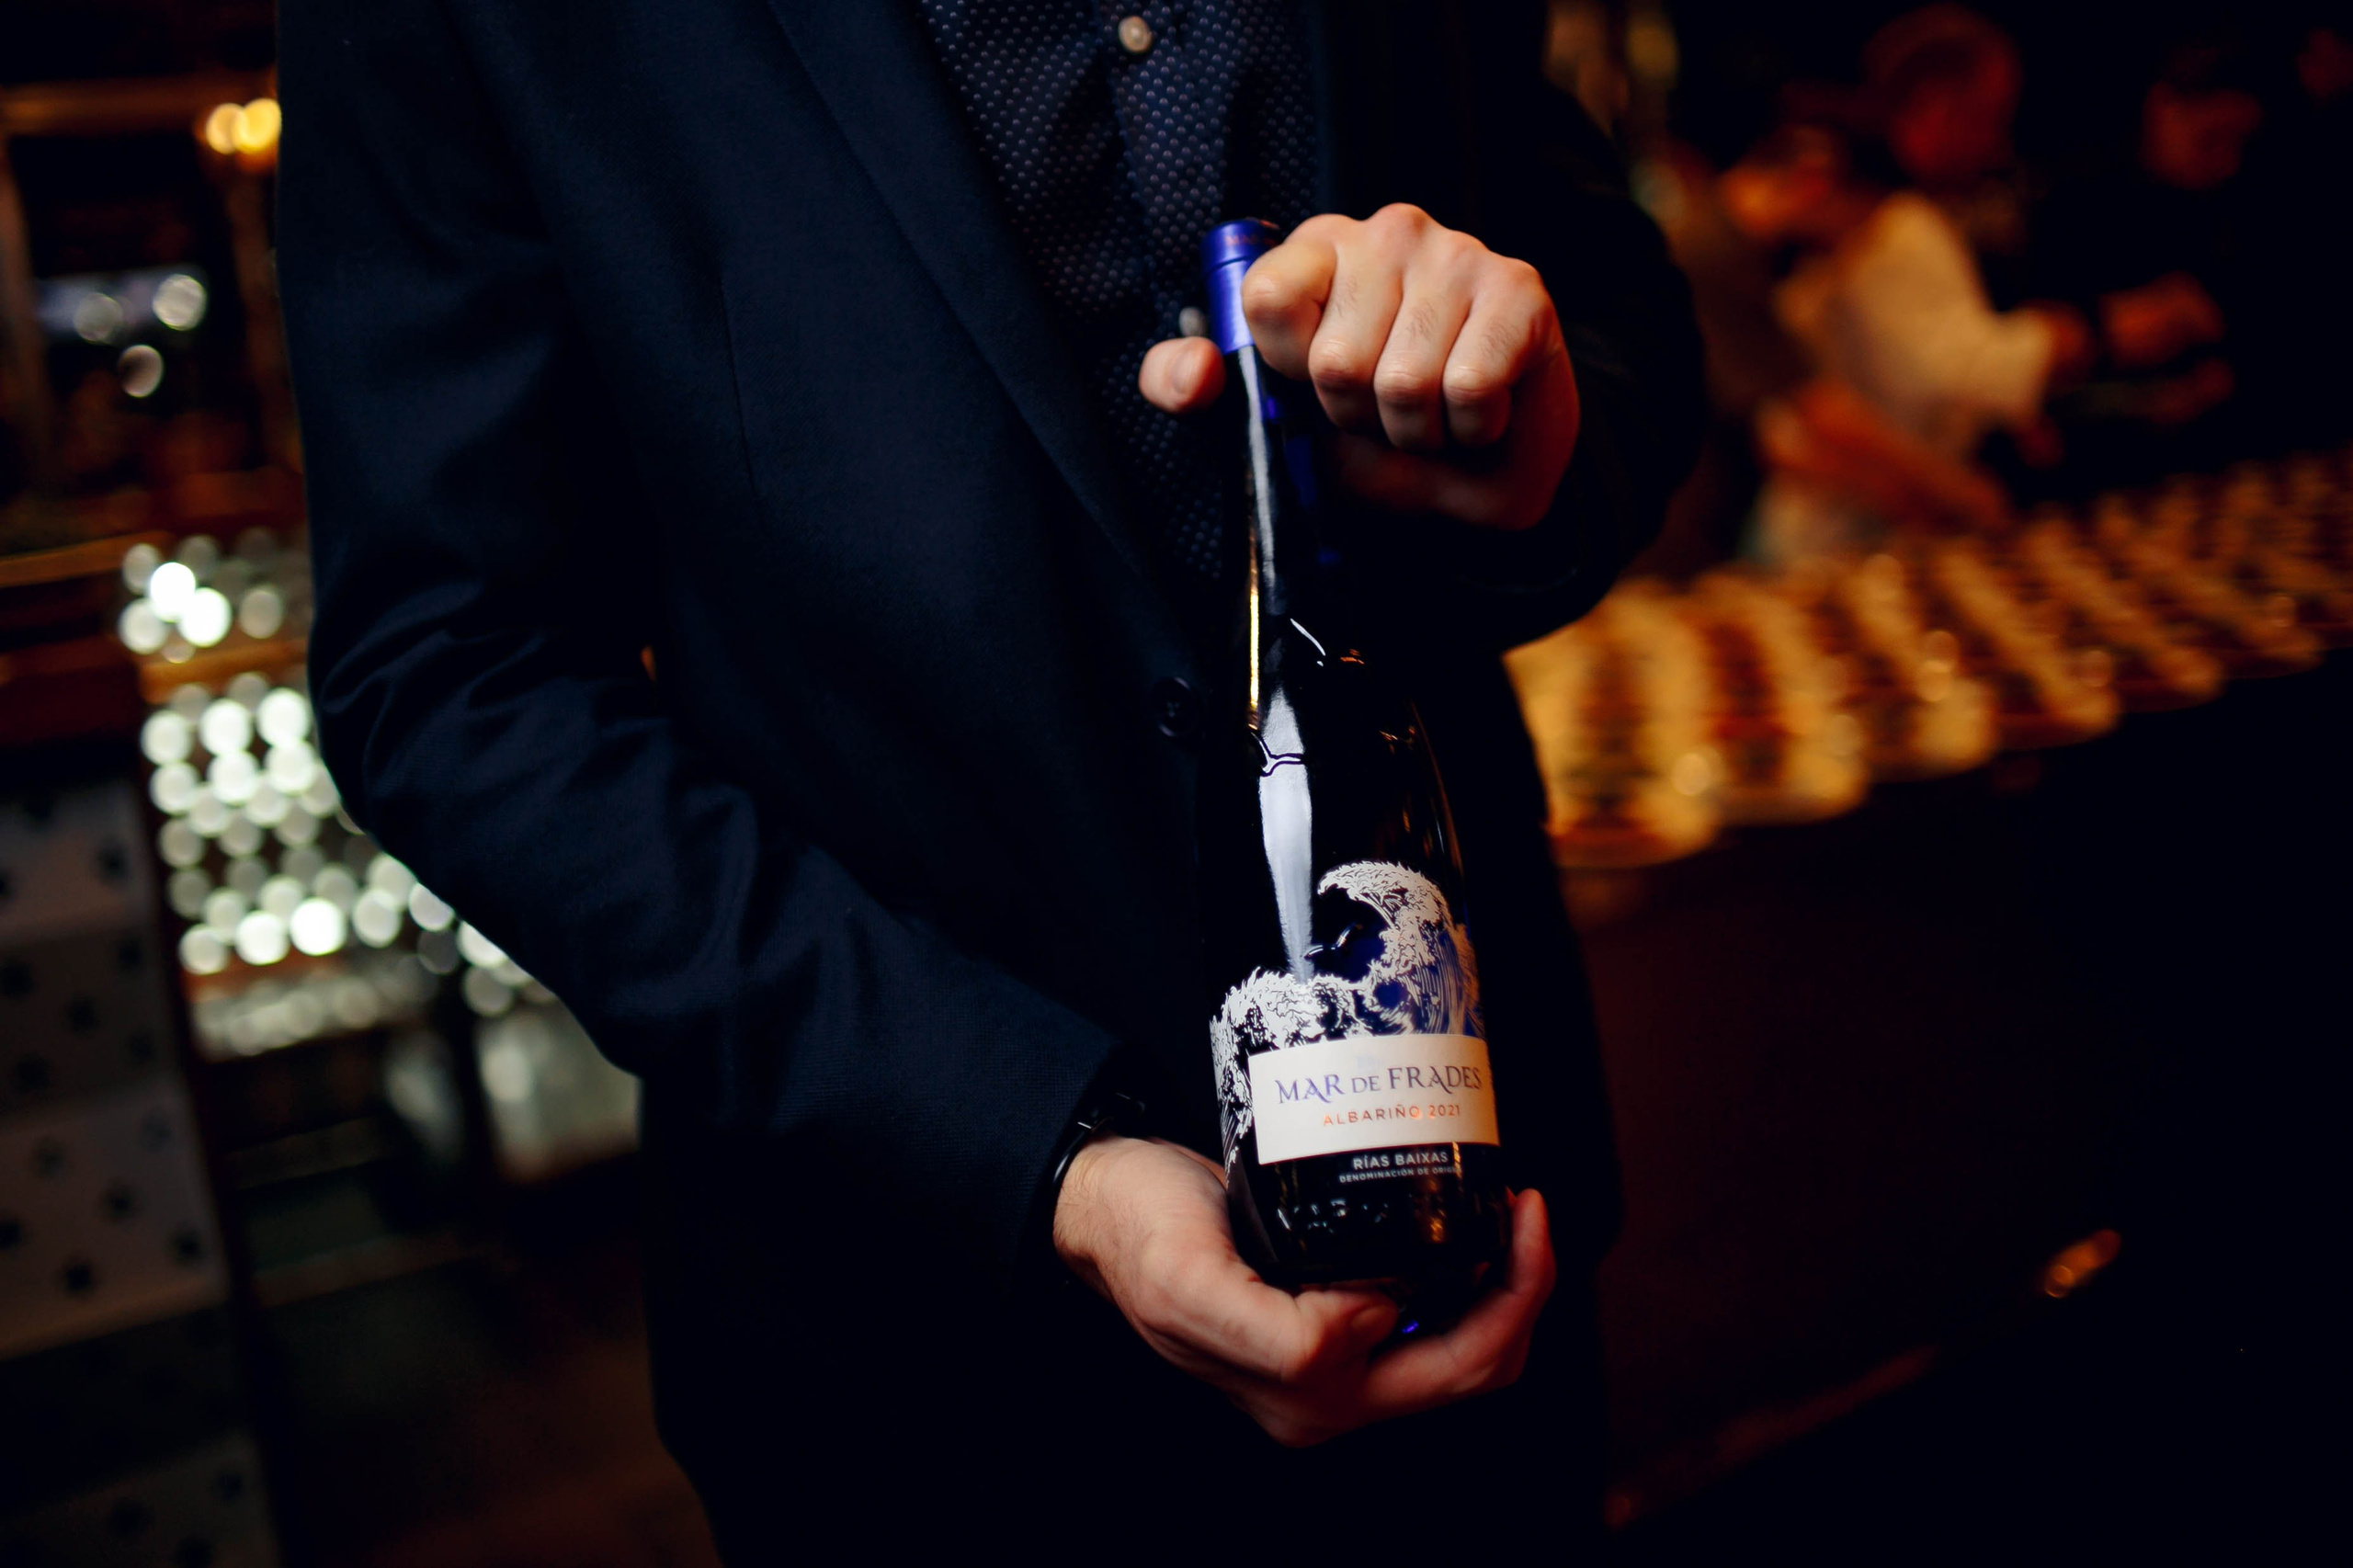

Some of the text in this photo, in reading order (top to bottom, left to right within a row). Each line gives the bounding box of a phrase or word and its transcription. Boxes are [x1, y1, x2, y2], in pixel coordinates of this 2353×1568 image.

[1274, 1065, 1482, 1104] MAR DE FRADES
[1323, 1104, 1461, 1126] ALBARIÑO 2021
[1352, 1151, 1449, 1170] RÍAS BAIXAS
[1338, 1165, 1460, 1184] DENOMINACIÓN DE ORIG
